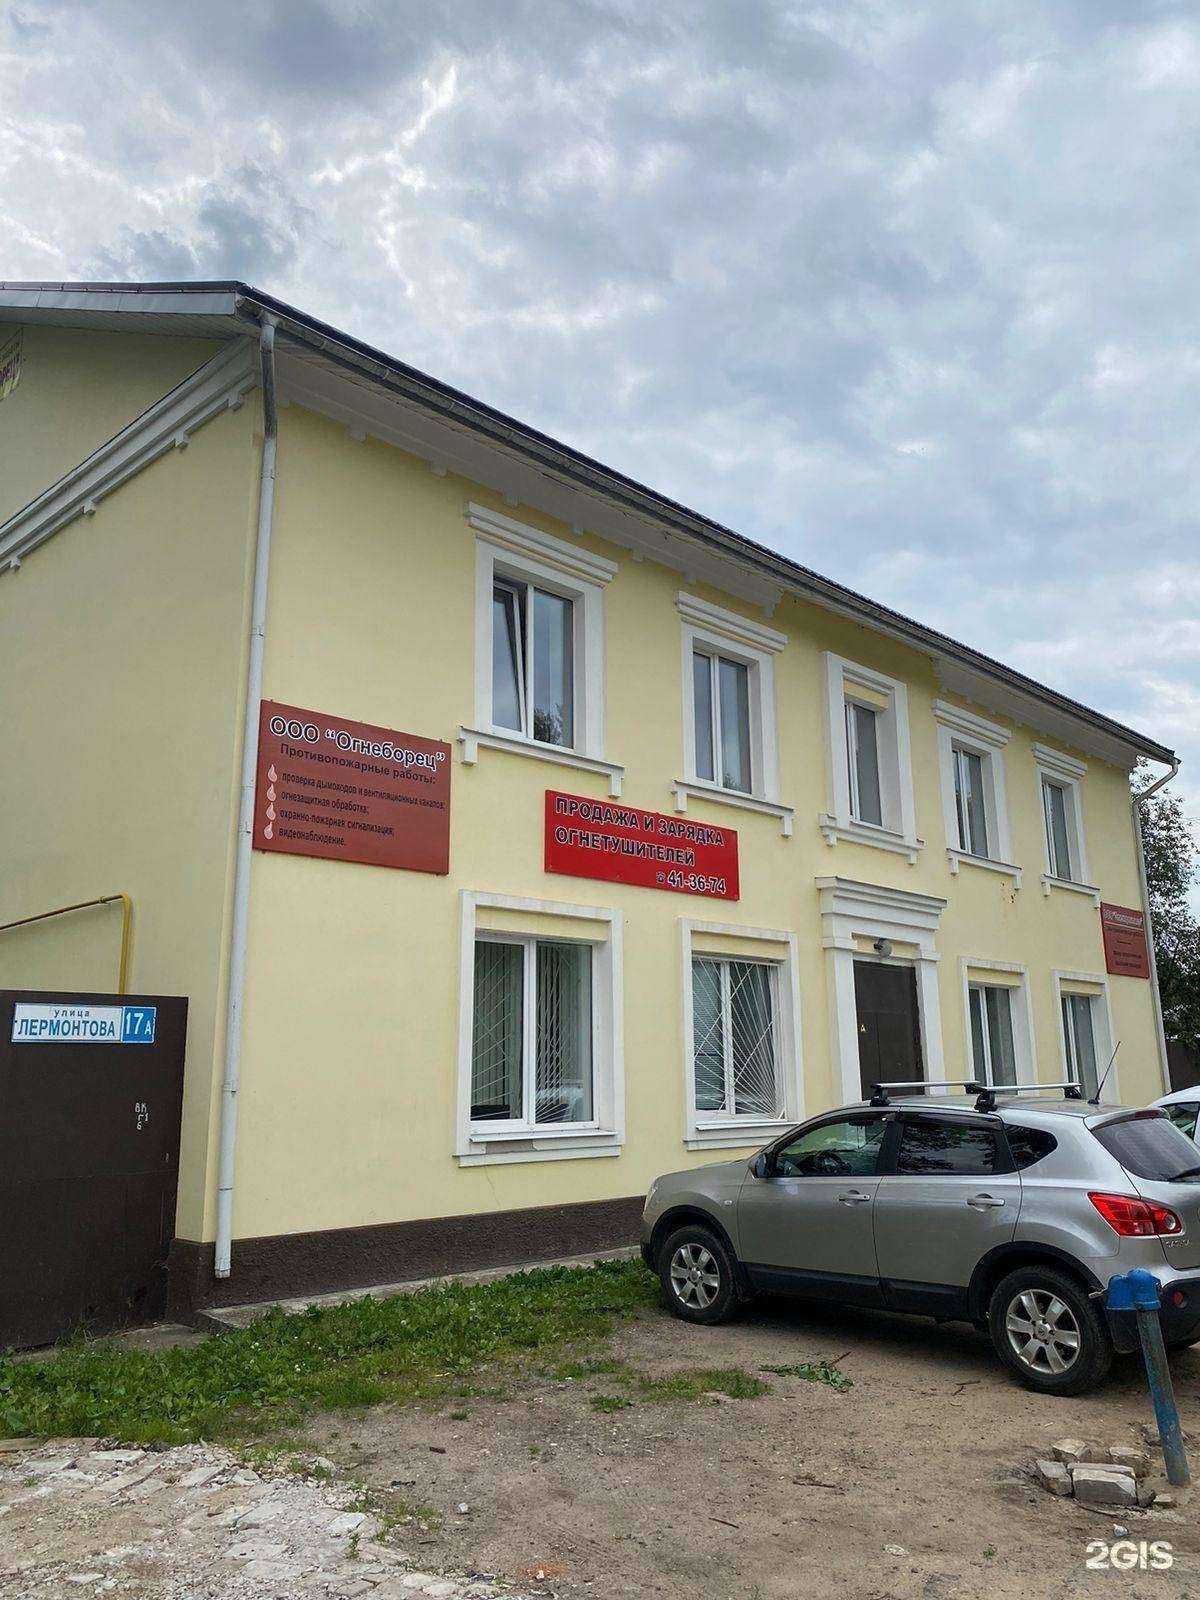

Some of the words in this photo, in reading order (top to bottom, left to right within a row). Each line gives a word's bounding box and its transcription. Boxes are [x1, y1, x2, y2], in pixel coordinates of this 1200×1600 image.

[269, 715, 320, 744] ООО
[280, 743, 390, 776] Противопожарные
[393, 769, 436, 785] работы:
[282, 772, 316, 787] проверка
[316, 779, 357, 795] дымоходов
[281, 791, 331, 807] огнезащитная
[279, 809, 346, 829] охранно-пожарная
[555, 797, 640, 830] ПРОДАЖА
[644, 815, 655, 831] И
[658, 819, 724, 846] ЗАРЯДКА
[554, 826, 696, 867] ОГНЕТУШИТЕЛЕЙ
[667, 870, 727, 894] 41-36-74
[54, 1009, 90, 1018] улица
[17, 1018, 115, 1037] ЛЕРМОНТОВА
